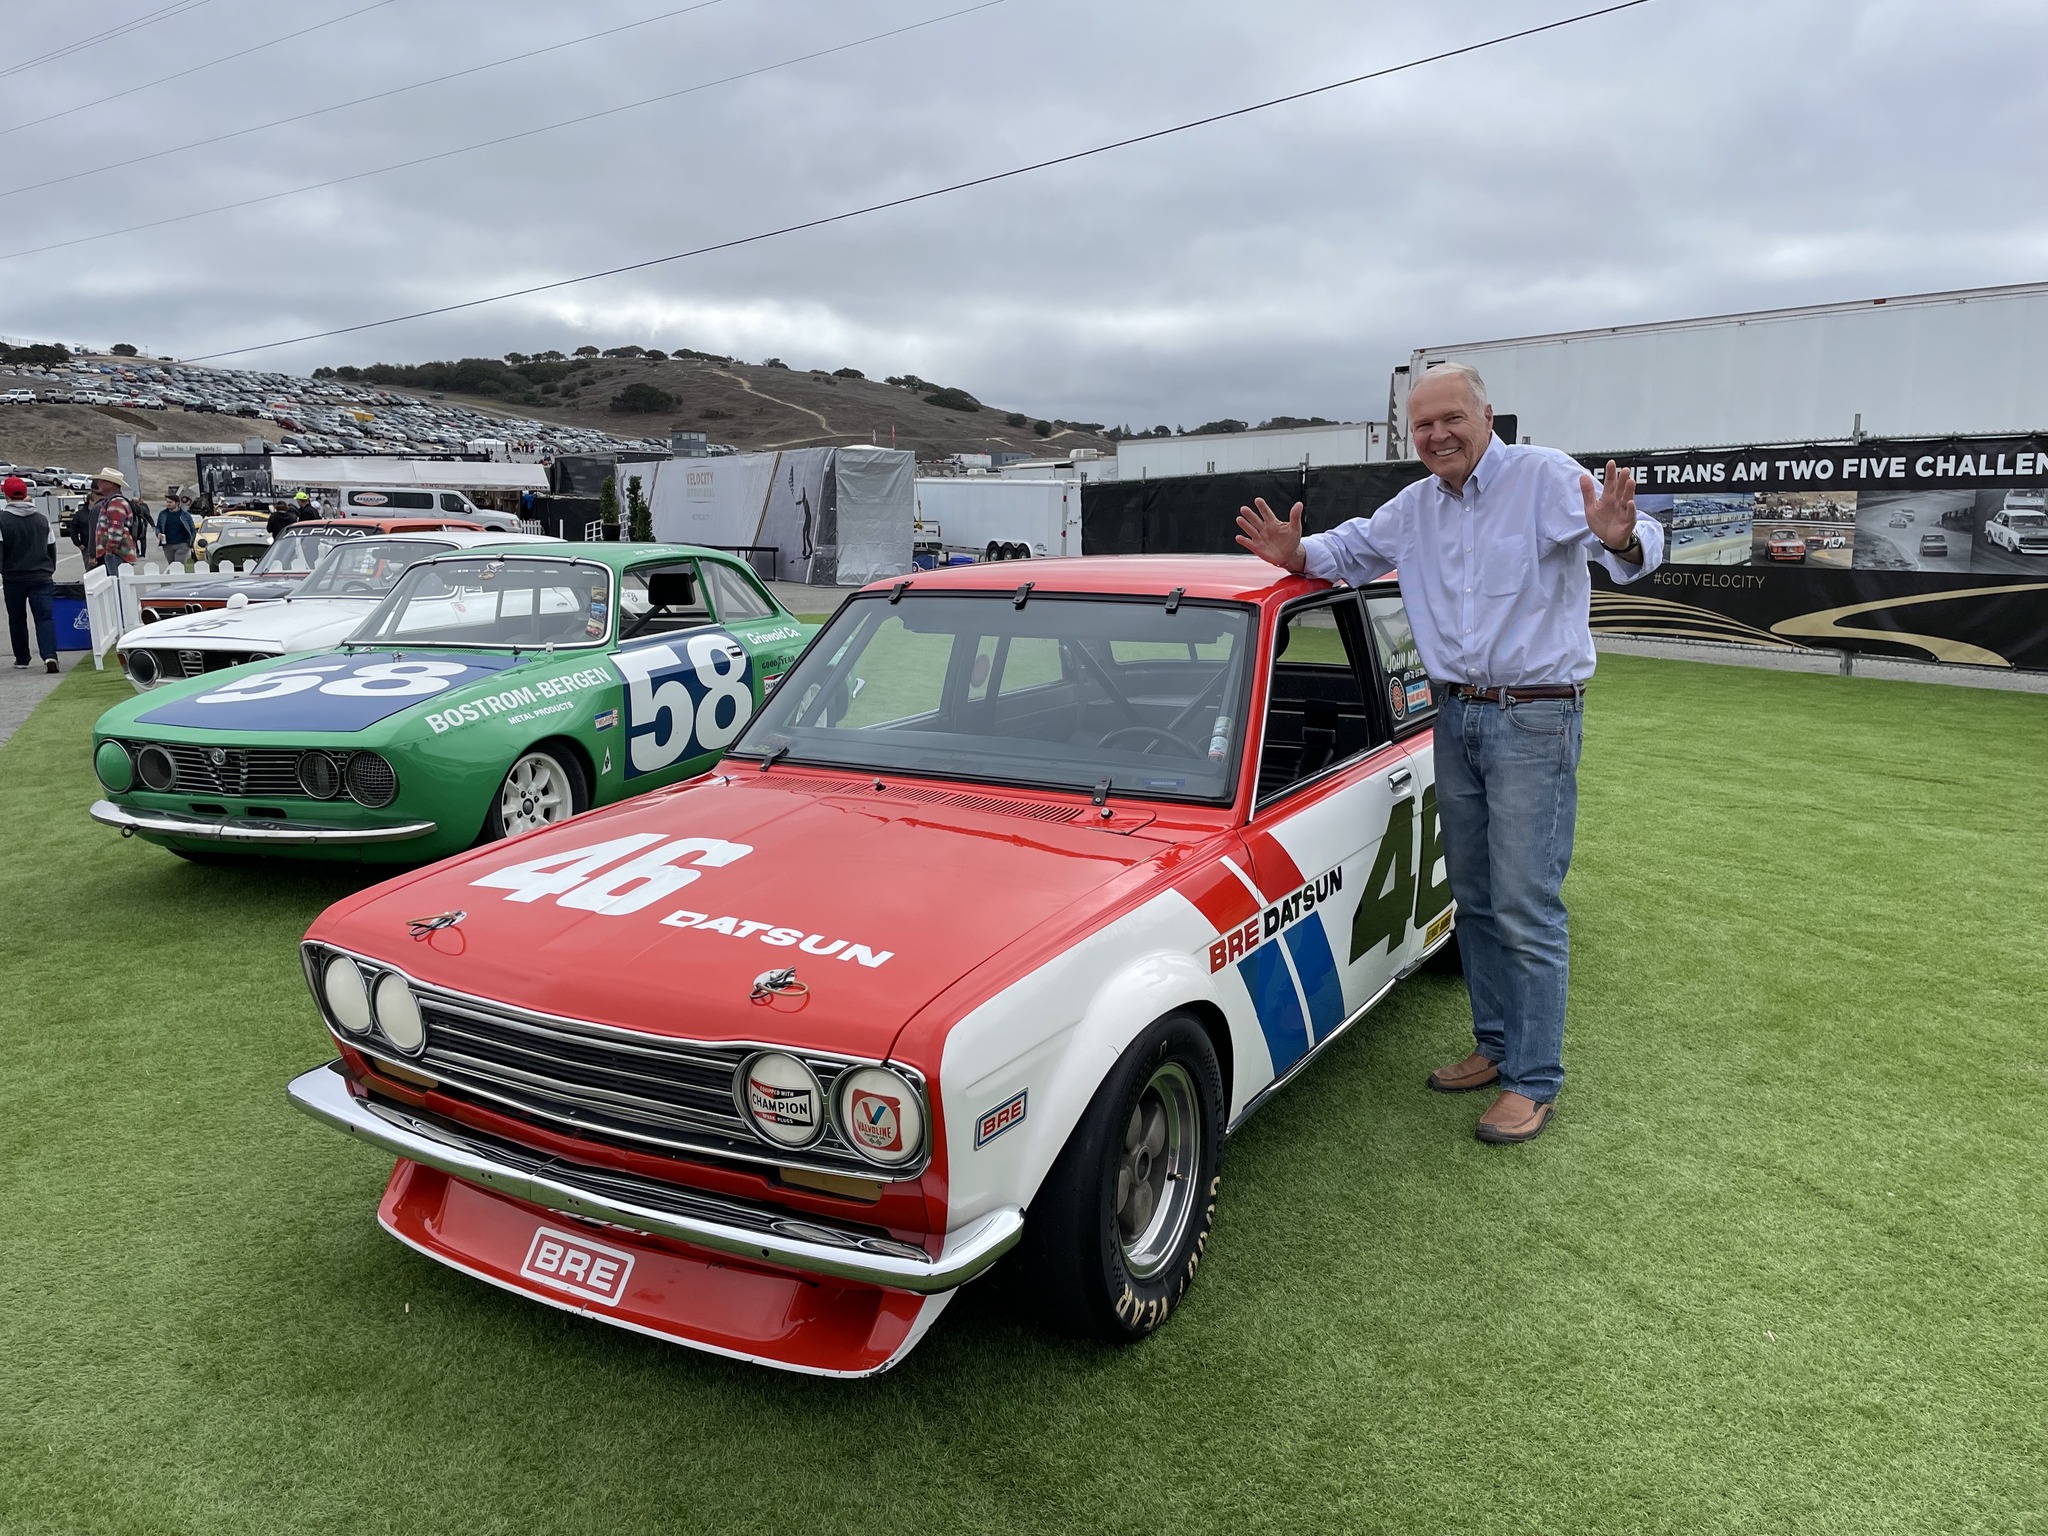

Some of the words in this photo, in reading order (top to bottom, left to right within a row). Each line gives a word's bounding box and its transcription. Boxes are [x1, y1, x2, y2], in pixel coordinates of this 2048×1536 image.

[686, 471, 714, 486] VELOCITY
[1653, 462, 1726, 484] TRANS
[1731, 461, 1768, 482] AM
[1775, 459, 1834, 481] TWO
[1842, 456, 1907, 479] FIVE
[283, 527, 367, 538] ALPINA
[1653, 572, 1765, 589] #GOTVELOCITY
[746, 627, 788, 645] Griswold
[783, 626, 802, 638] Co.
[1386, 651, 1406, 674] JOHN
[195, 660, 468, 704] 58
[424, 666, 612, 734] BOSTROM-BERGEN
[507, 711, 535, 725] METAL
[534, 701, 574, 718] PRODUCTS
[608, 634, 752, 772] 58
[468, 832, 754, 916] 46
[1209, 917, 1260, 975] BRE
[1263, 865, 1343, 939] DATSUN
[658, 910, 895, 968] DATSUN
[752, 1093, 808, 1115] CHAMPION
[777, 1116, 794, 1124] PLUGS
[856, 1119, 892, 1139] VALVOLINE
[983, 1099, 1022, 1138] BRE
[534, 1240, 620, 1292] BRE
